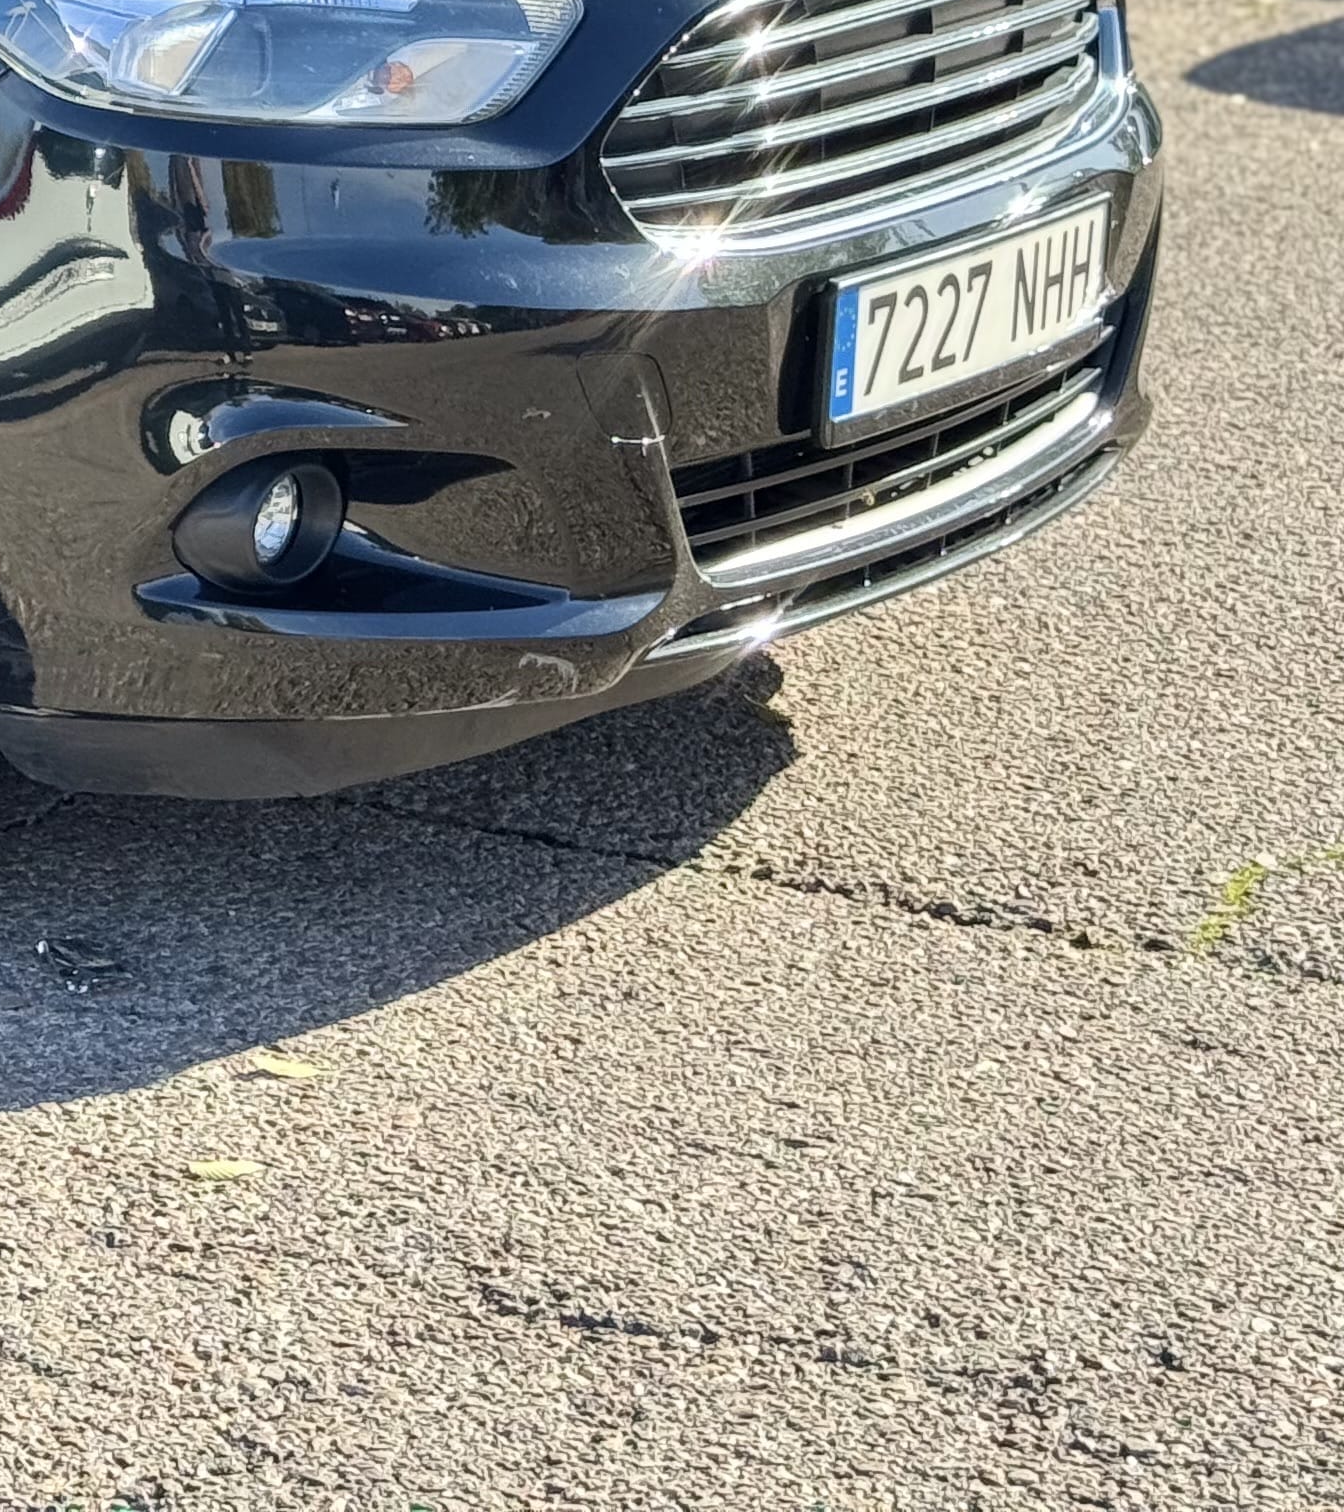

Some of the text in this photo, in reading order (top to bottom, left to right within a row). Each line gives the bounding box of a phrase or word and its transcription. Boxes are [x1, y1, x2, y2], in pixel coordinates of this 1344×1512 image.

[863, 219, 1095, 397] 7227 NHH
[834, 368, 848, 397] E
